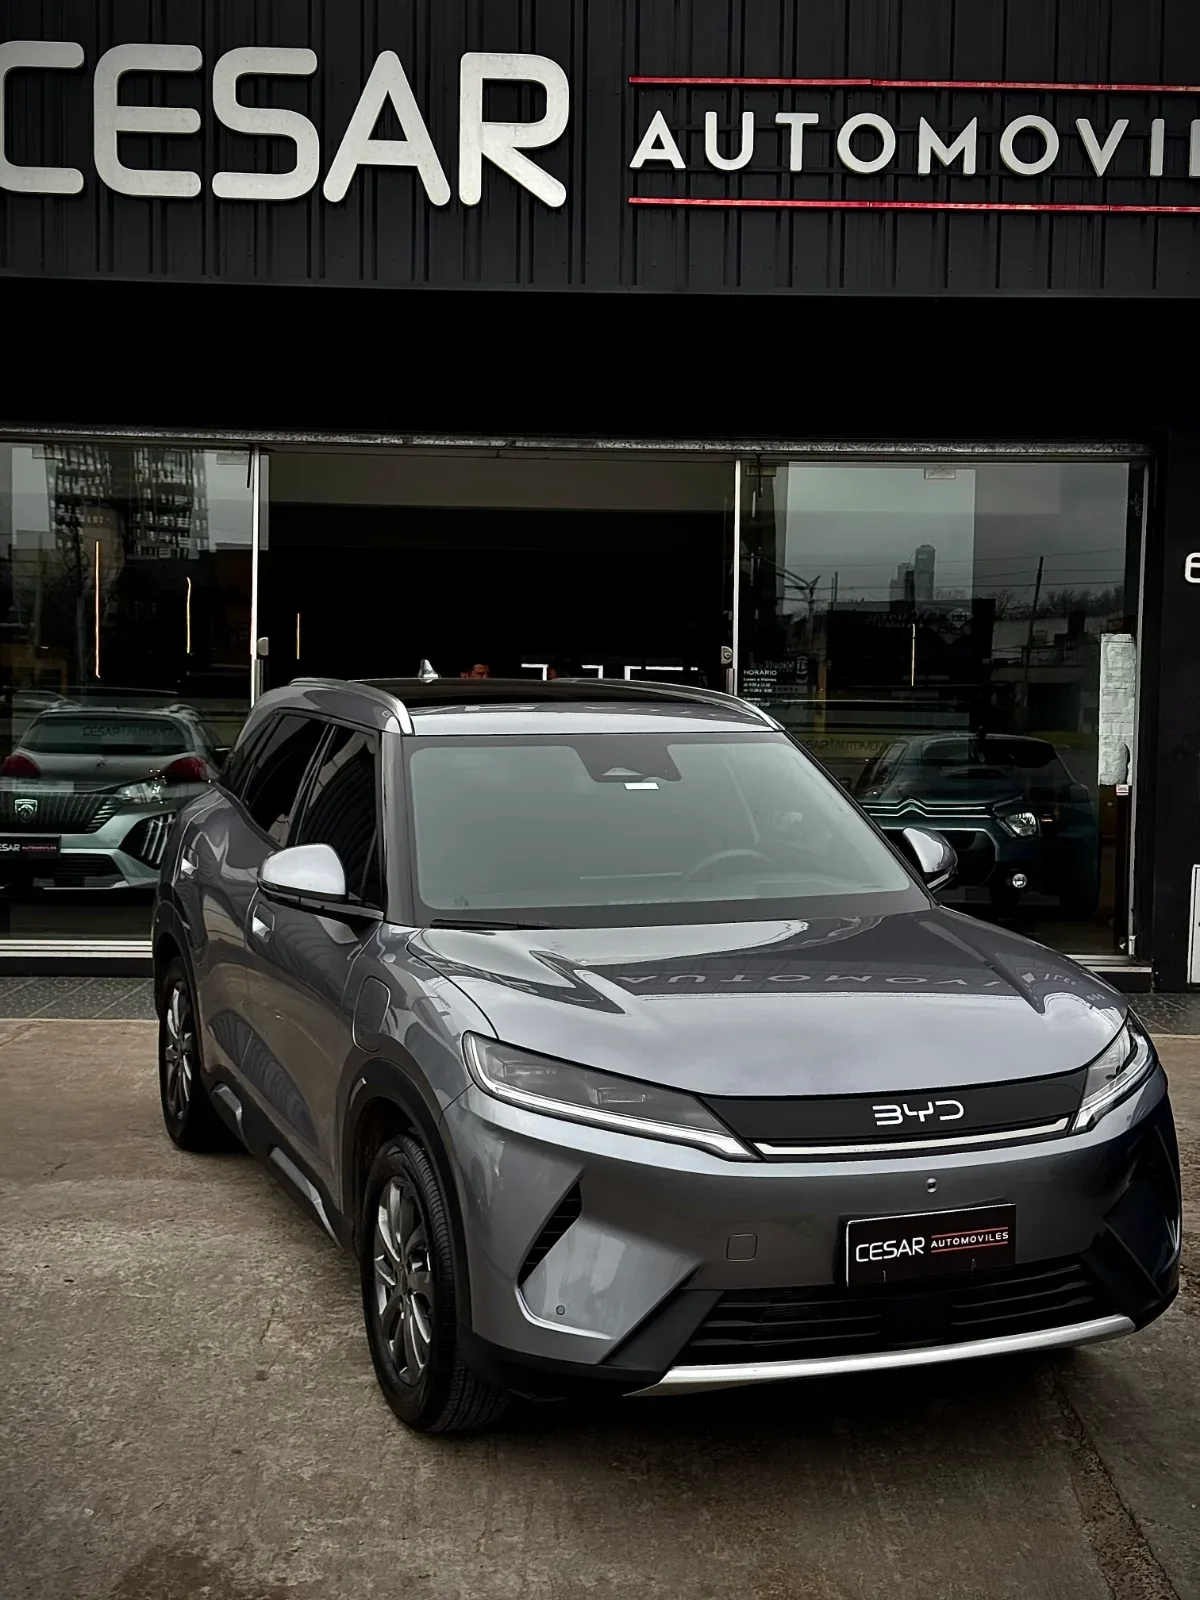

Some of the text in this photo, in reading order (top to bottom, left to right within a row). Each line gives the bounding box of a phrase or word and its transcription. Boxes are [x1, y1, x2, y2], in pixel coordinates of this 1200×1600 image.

[0, 40, 570, 208] CESAR
[872, 1099, 965, 1126] BYD
[855, 1230, 1010, 1263] CESAR AUTOMOVILES
